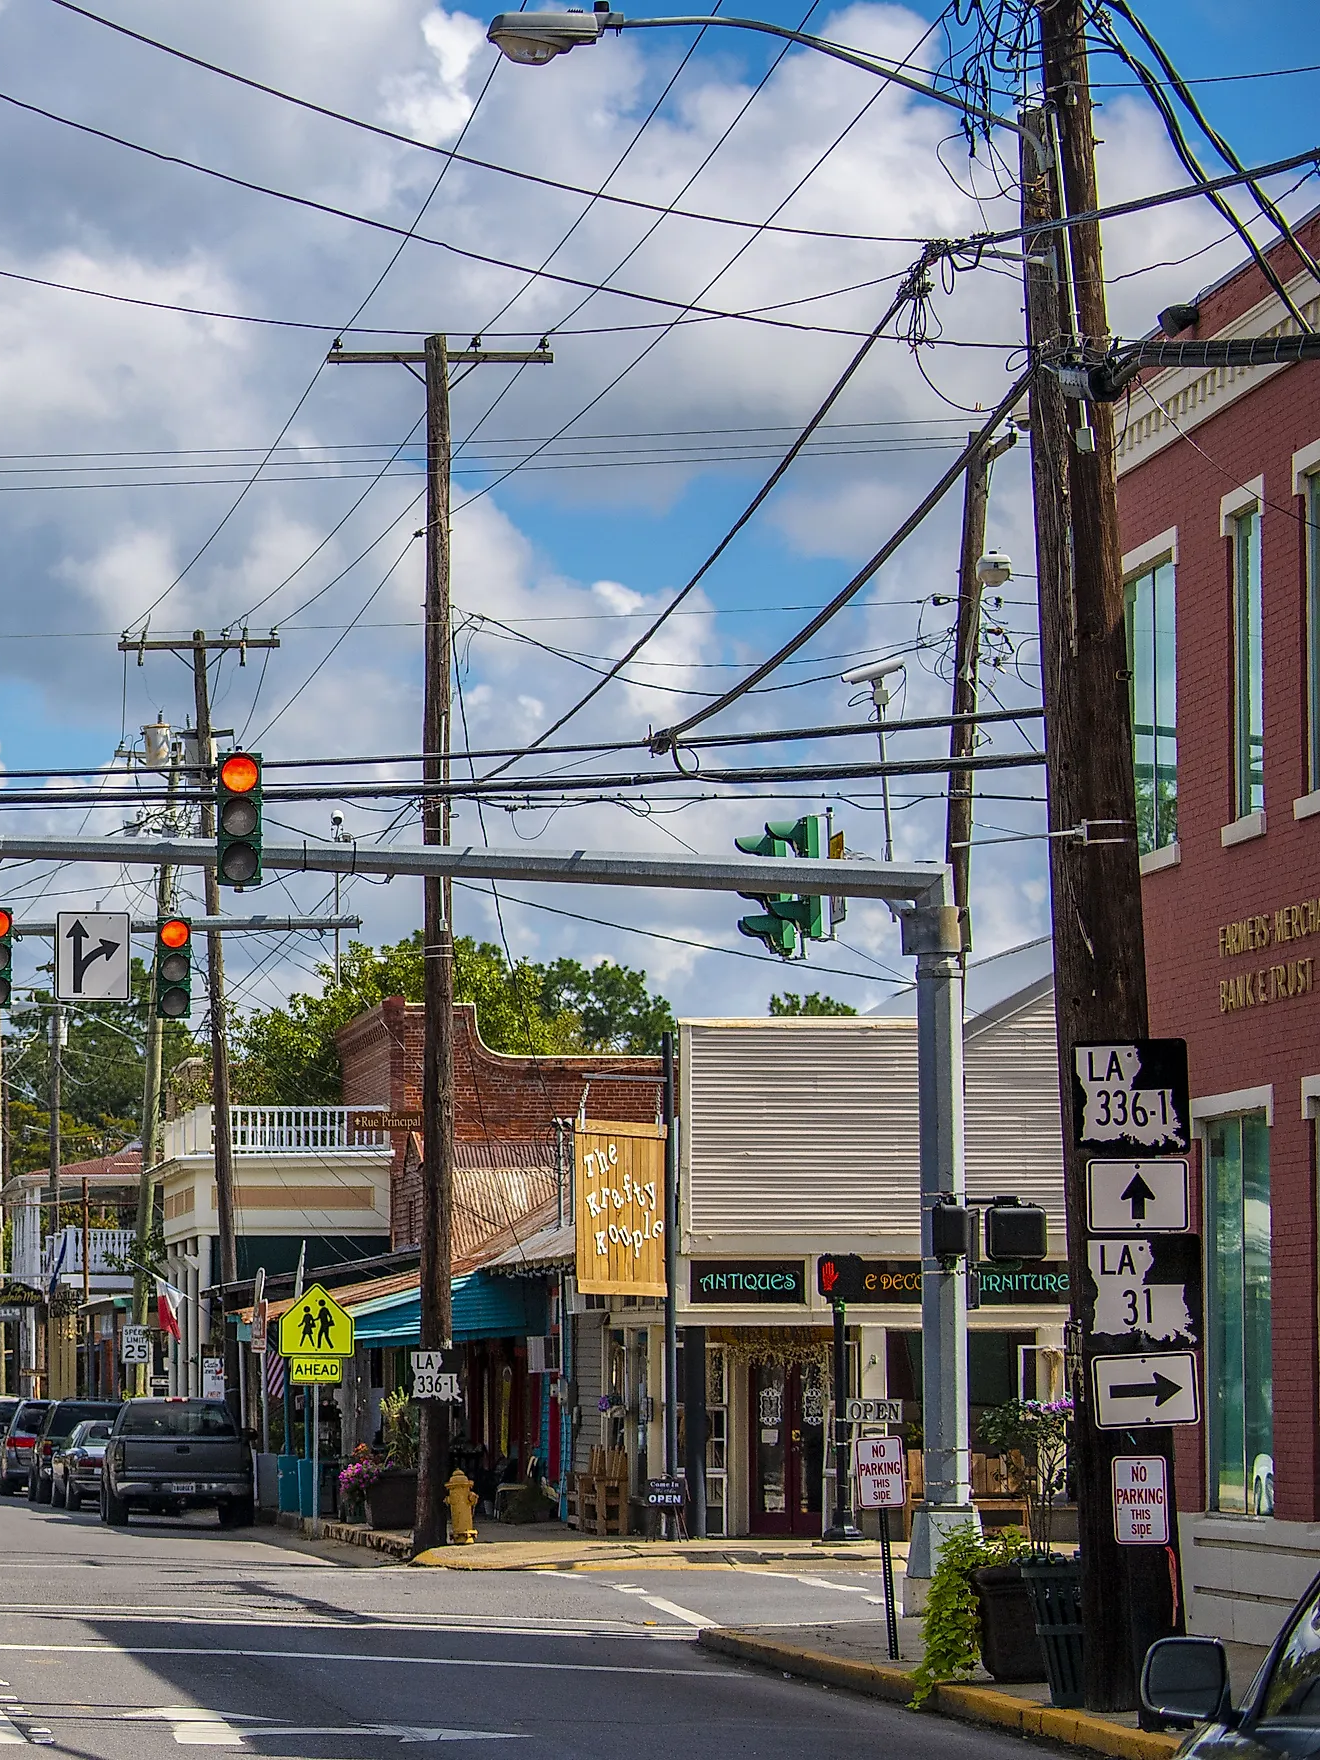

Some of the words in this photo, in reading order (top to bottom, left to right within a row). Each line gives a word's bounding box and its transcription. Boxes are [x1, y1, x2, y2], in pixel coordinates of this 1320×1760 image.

[1220, 973, 1255, 1012] BANK
[1258, 970, 1268, 1003] &
[1269, 957, 1314, 999] TRUST
[1088, 1051, 1125, 1082] LA
[1095, 1088, 1168, 1127] 336-1
[361, 1116, 379, 1127] Rue
[382, 1115, 421, 1130] Principal
[583, 1143, 618, 1178] The
[585, 1173, 656, 1218] Krafty
[594, 1211, 664, 1258] Kouple
[1099, 1244, 1137, 1276] LA
[699, 1273, 796, 1292] ANTIQUES
[880, 1273, 922, 1290] DECO
[980, 1273, 1071, 1293] URNITURE
[1122, 1288, 1153, 1326] 31
[125, 1345, 147, 1359] 25
[295, 1364, 339, 1376] AHEAD
[416, 1354, 434, 1369] LA
[417, 1375, 454, 1393] 336-1
[851, 1402, 900, 1420] OPEN
[871, 1444, 886, 1458] NO
[860, 1461, 901, 1477] PARKING
[1131, 1465, 1147, 1482] NO
[872, 1479, 890, 1489] THIS
[648, 1494, 682, 1504] OPEN
[872, 1490, 891, 1500] SIDE
[1117, 1488, 1163, 1505] PARKING
[1130, 1509, 1151, 1520] THIS
[1131, 1524, 1152, 1535] SIDE
